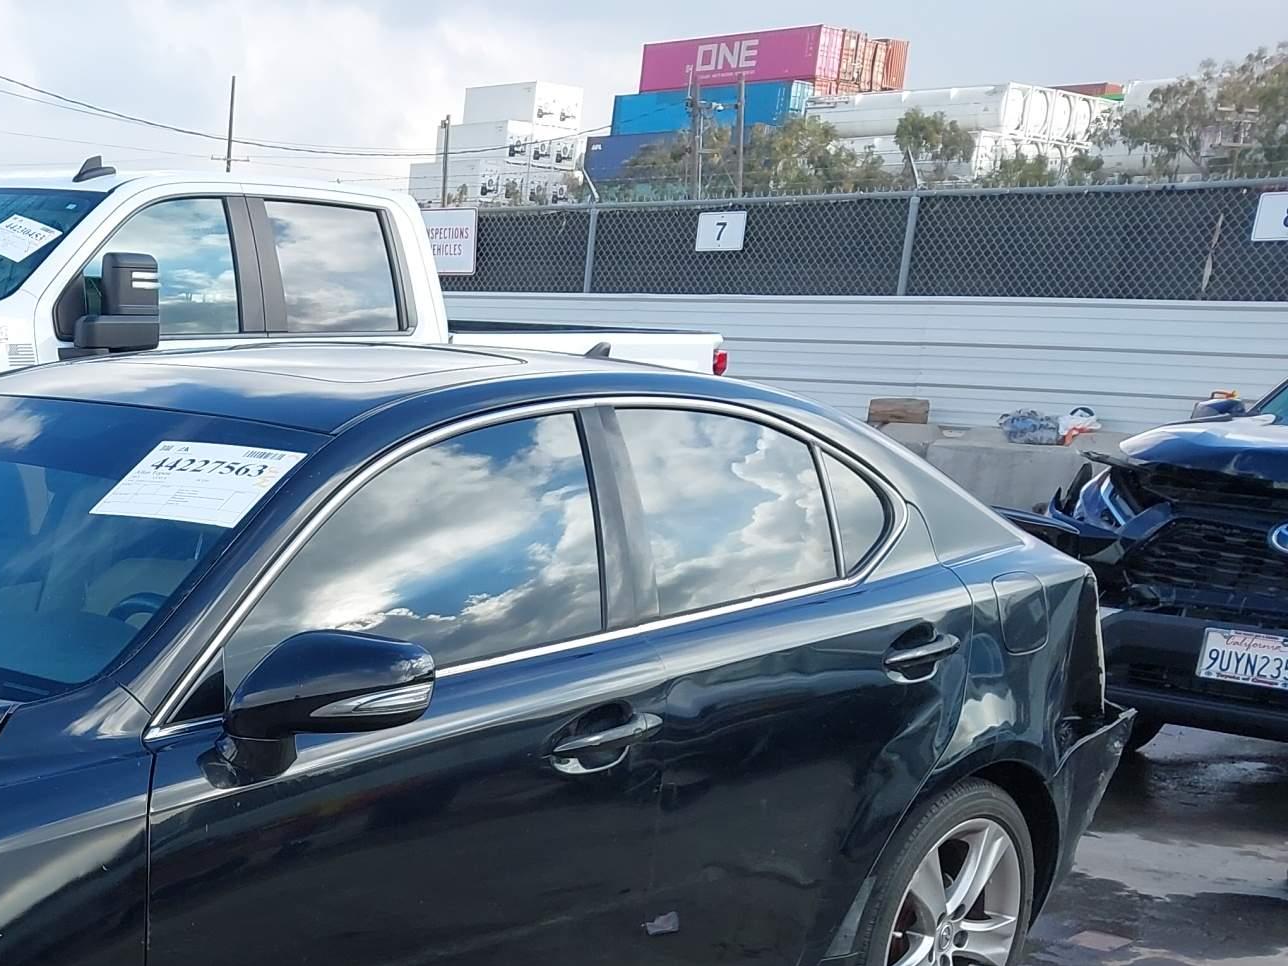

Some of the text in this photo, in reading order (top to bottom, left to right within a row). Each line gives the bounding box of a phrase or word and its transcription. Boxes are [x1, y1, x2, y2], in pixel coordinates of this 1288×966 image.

[695, 39, 760, 72] ONE
[716, 221, 728, 241] 7
[431, 243, 463, 256] EHICLES
[150, 456, 269, 478] 44227563
[1224, 634, 1282, 652] California
